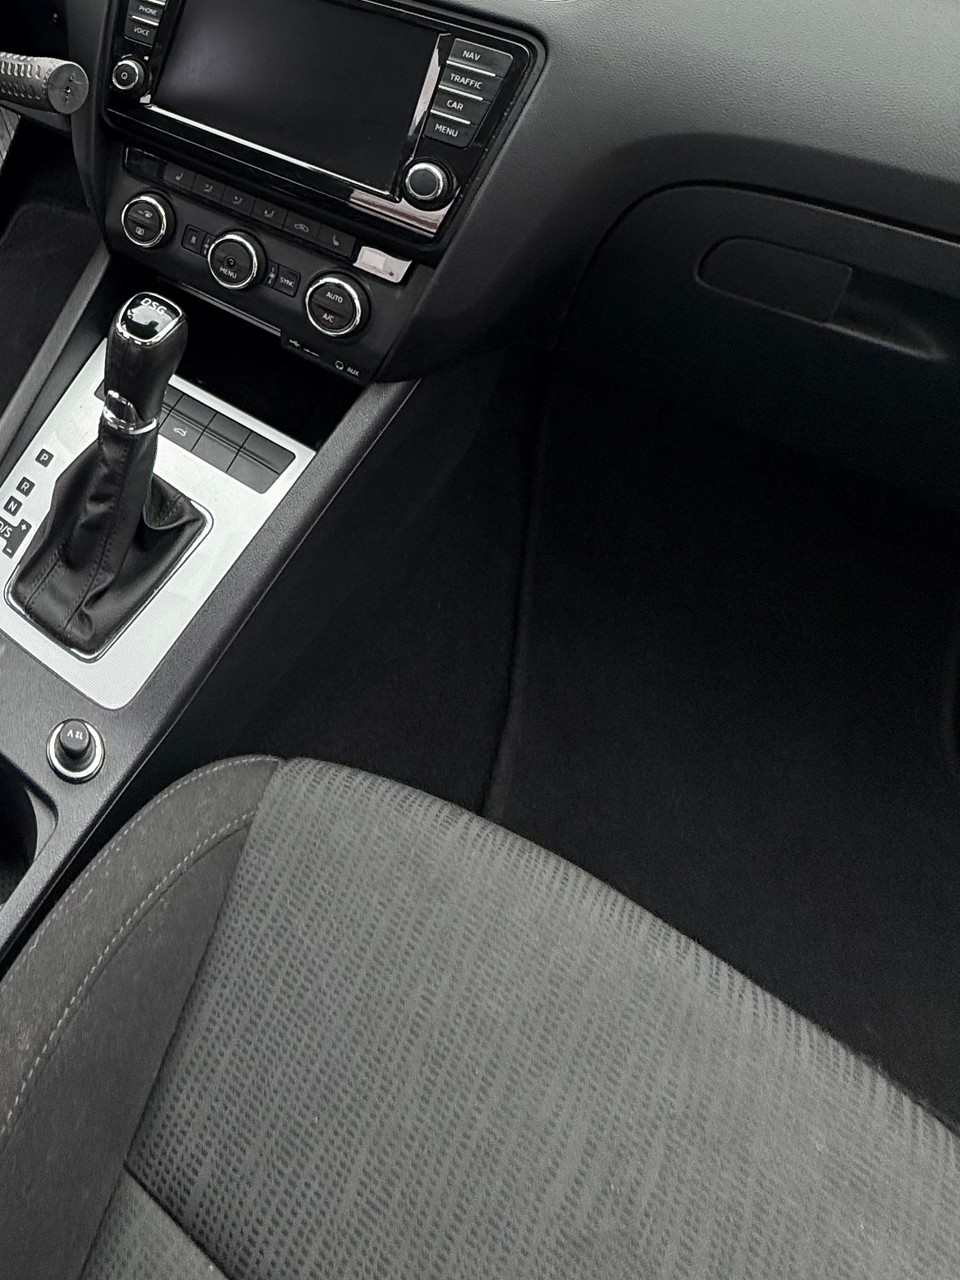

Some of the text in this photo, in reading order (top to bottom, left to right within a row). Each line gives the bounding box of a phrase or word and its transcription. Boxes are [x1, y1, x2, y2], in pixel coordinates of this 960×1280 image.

[138, 5, 158, 16] PHONE
[133, 26, 150, 37] VOICE
[462, 49, 481, 61] NAV
[450, 73, 483, 90] TRAFFIC
[446, 99, 464, 111] CAR
[434, 123, 459, 137] MENU
[219, 266, 238, 279] MENU
[279, 276, 295, 288] SYNC
[325, 291, 344, 304] AUTO
[140, 297, 168, 315] DSG
[322, 312, 335, 323] A/C
[40, 453, 49, 462] P
[20, 481, 30, 492] R
[8, 500, 18, 512] N
